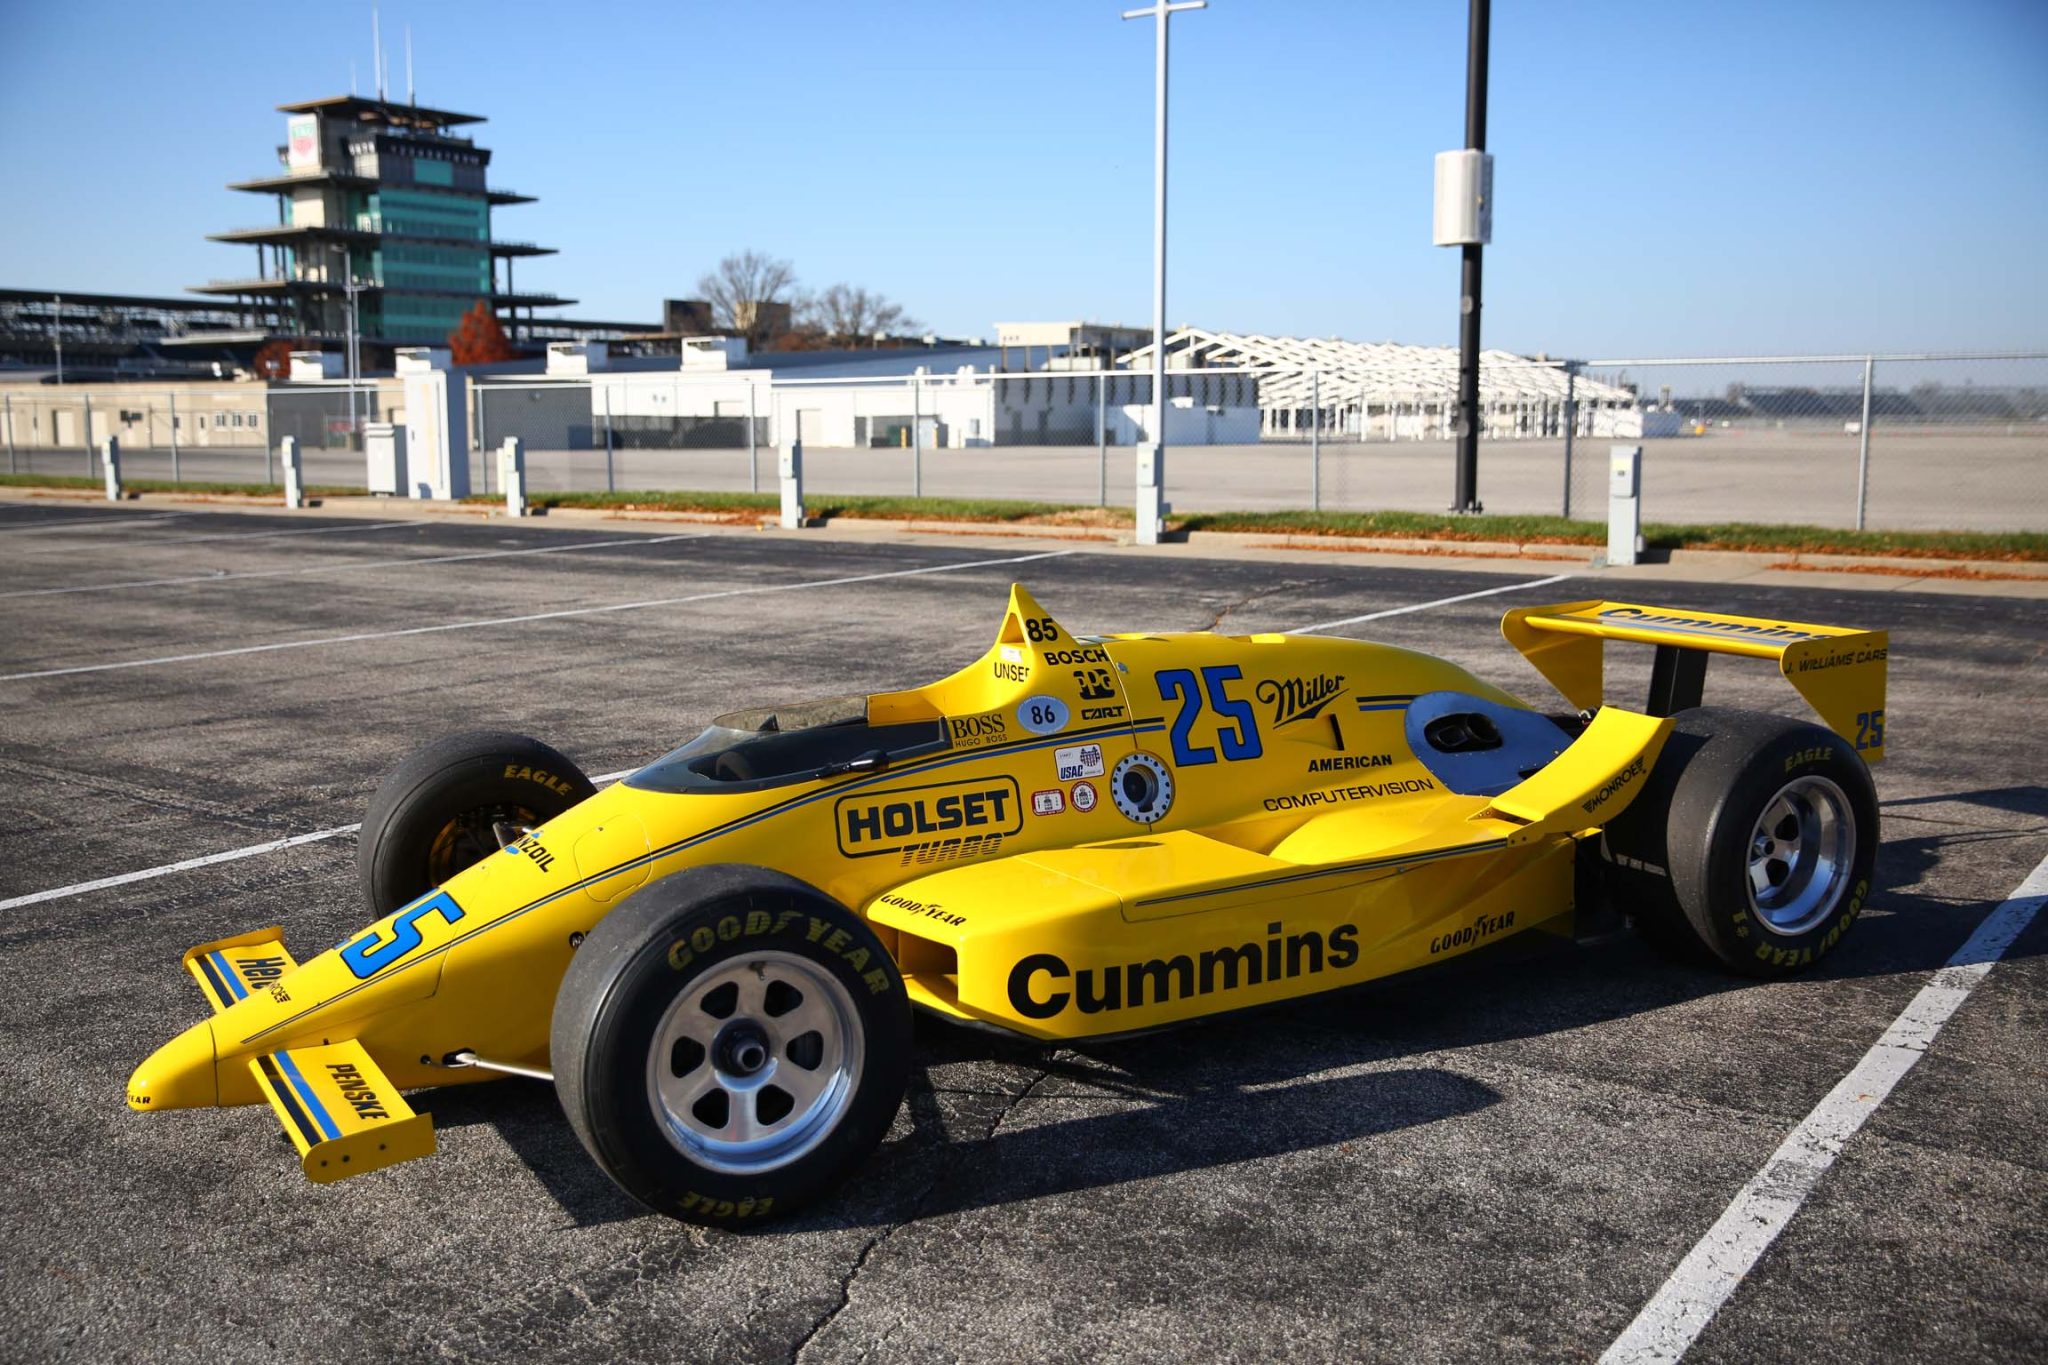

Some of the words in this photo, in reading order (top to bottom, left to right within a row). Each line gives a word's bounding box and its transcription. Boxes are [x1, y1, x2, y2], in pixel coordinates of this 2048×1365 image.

[1025, 618, 1059, 642] 85
[1044, 649, 1110, 666] BOSCH
[1856, 648, 1887, 663] CARS
[1081, 706, 1125, 721] CART
[1255, 673, 1348, 726] Miller
[952, 713, 1006, 740] BOSS
[1031, 705, 1056, 725] 86
[1154, 664, 1263, 767] 25
[1855, 710, 1884, 750] 25
[955, 737, 982, 748] HUGO
[985, 733, 1008, 744] BOSS
[1060, 764, 1083, 780] USAC
[1307, 754, 1393, 773] AMERICAN
[1784, 747, 1833, 773] EAGLE
[503, 764, 574, 797] EAGLE
[1263, 778, 1435, 813] COMPUTERVISION
[1589, 762, 1639, 813] MONROE
[847, 788, 1010, 844] HOLSET
[900, 832, 1004, 868] TURBO
[1007, 920, 1359, 1020] Cummins
[325, 1062, 390, 1120] PENSKE
